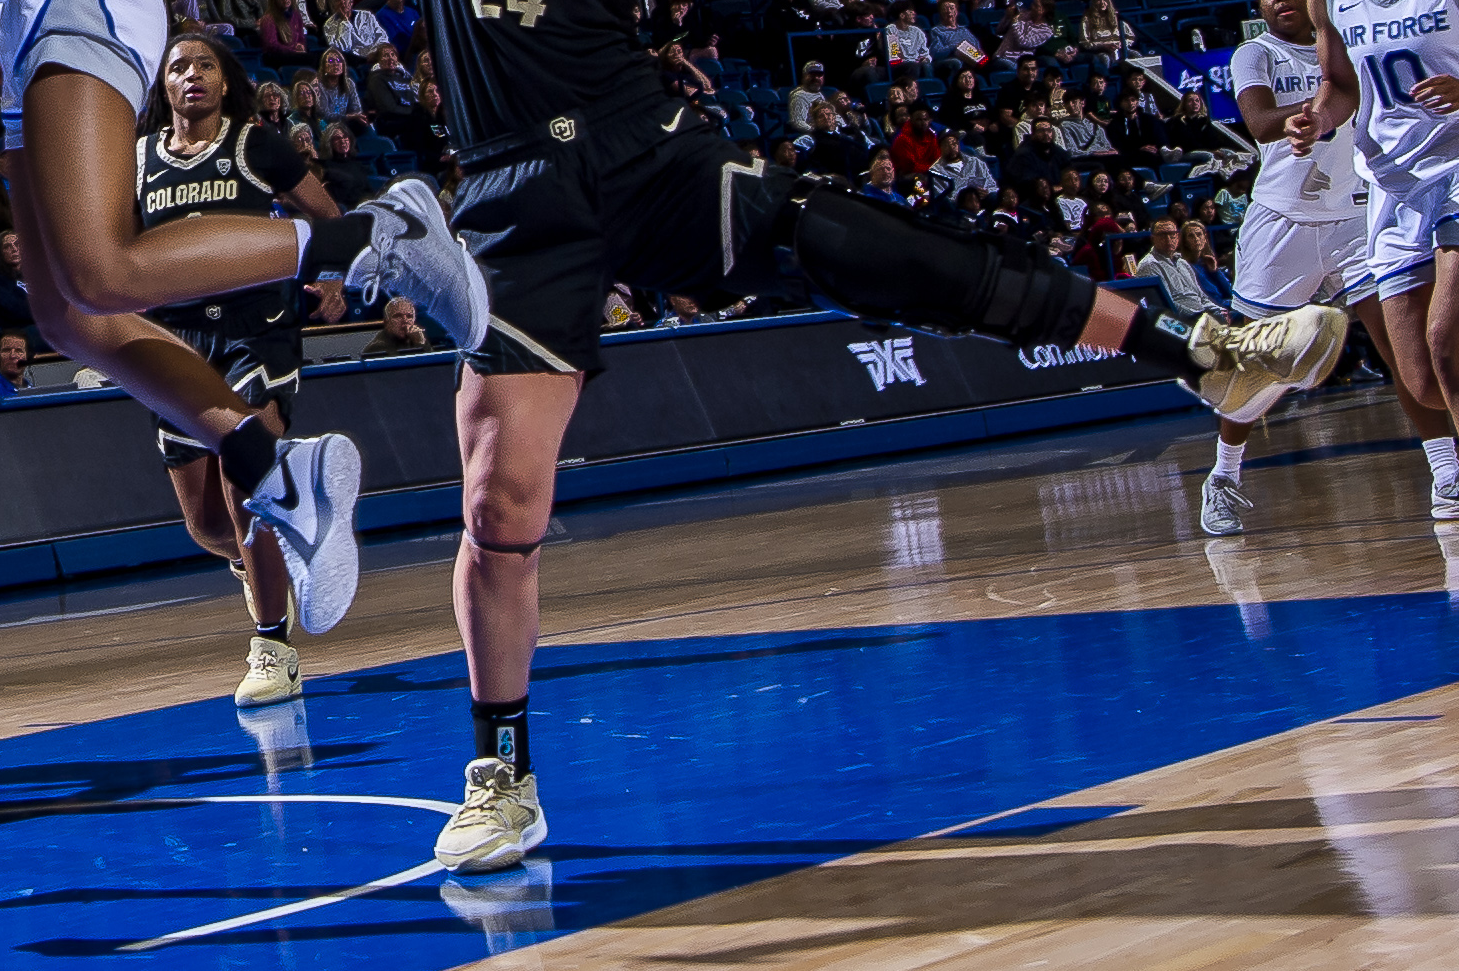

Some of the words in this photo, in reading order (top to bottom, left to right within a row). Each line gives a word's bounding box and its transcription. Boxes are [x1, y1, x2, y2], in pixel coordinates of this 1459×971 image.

[1372, 10, 1451, 45] FORCE
[1275, 76, 1303, 94] AIR
[1364, 49, 1428, 110] 10
[146, 179, 238, 214] COLORADO
